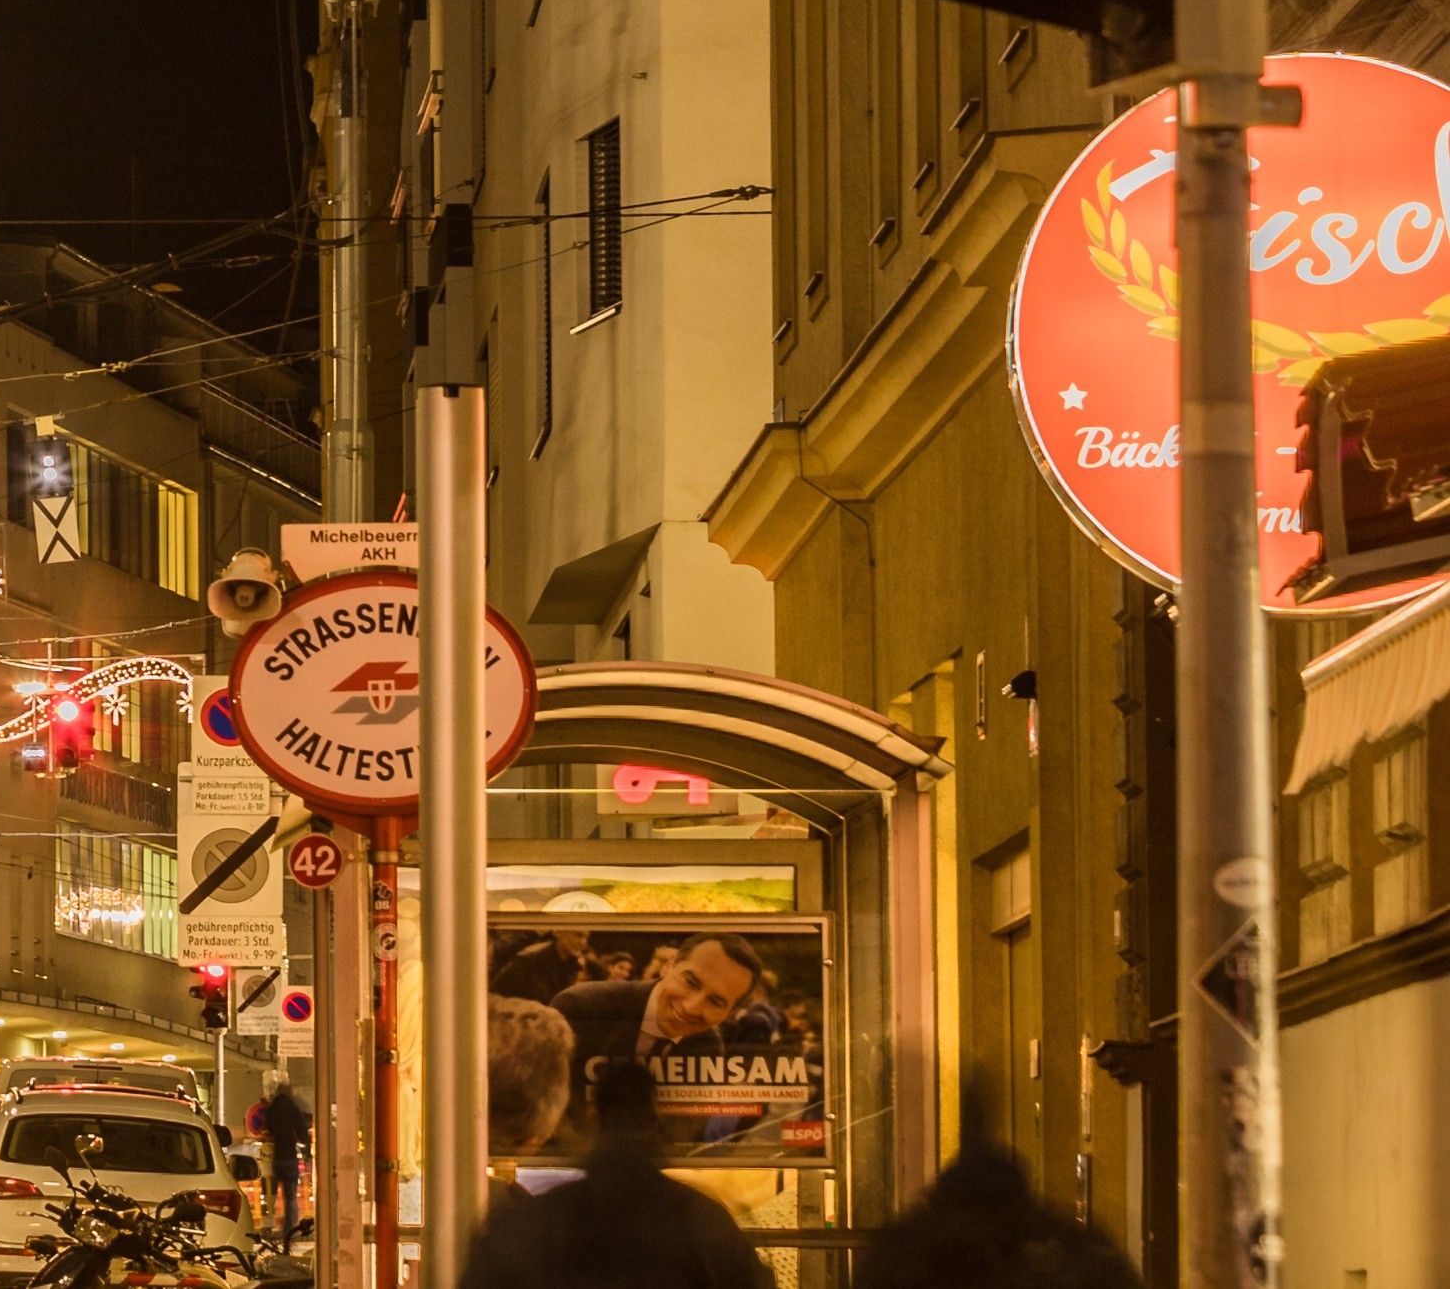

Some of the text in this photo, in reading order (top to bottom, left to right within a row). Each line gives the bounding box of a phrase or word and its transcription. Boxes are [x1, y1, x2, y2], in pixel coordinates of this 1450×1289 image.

[360, 547, 397, 561] AKH
[197, 781, 264, 791] gebührenpflichtig
[293, 844, 336, 878] 42
[186, 922, 275, 934] gebührenpflichtig
[188, 935, 272, 947] Parkdauer: 3 Std.
[674, 1089, 713, 1099] SOZIALE
[716, 1089, 755, 1099] STIMME
[758, 1089, 771, 1099] IM
[773, 1089, 804, 1100] LAND!
[793, 1126, 823, 1141] SPÖ
